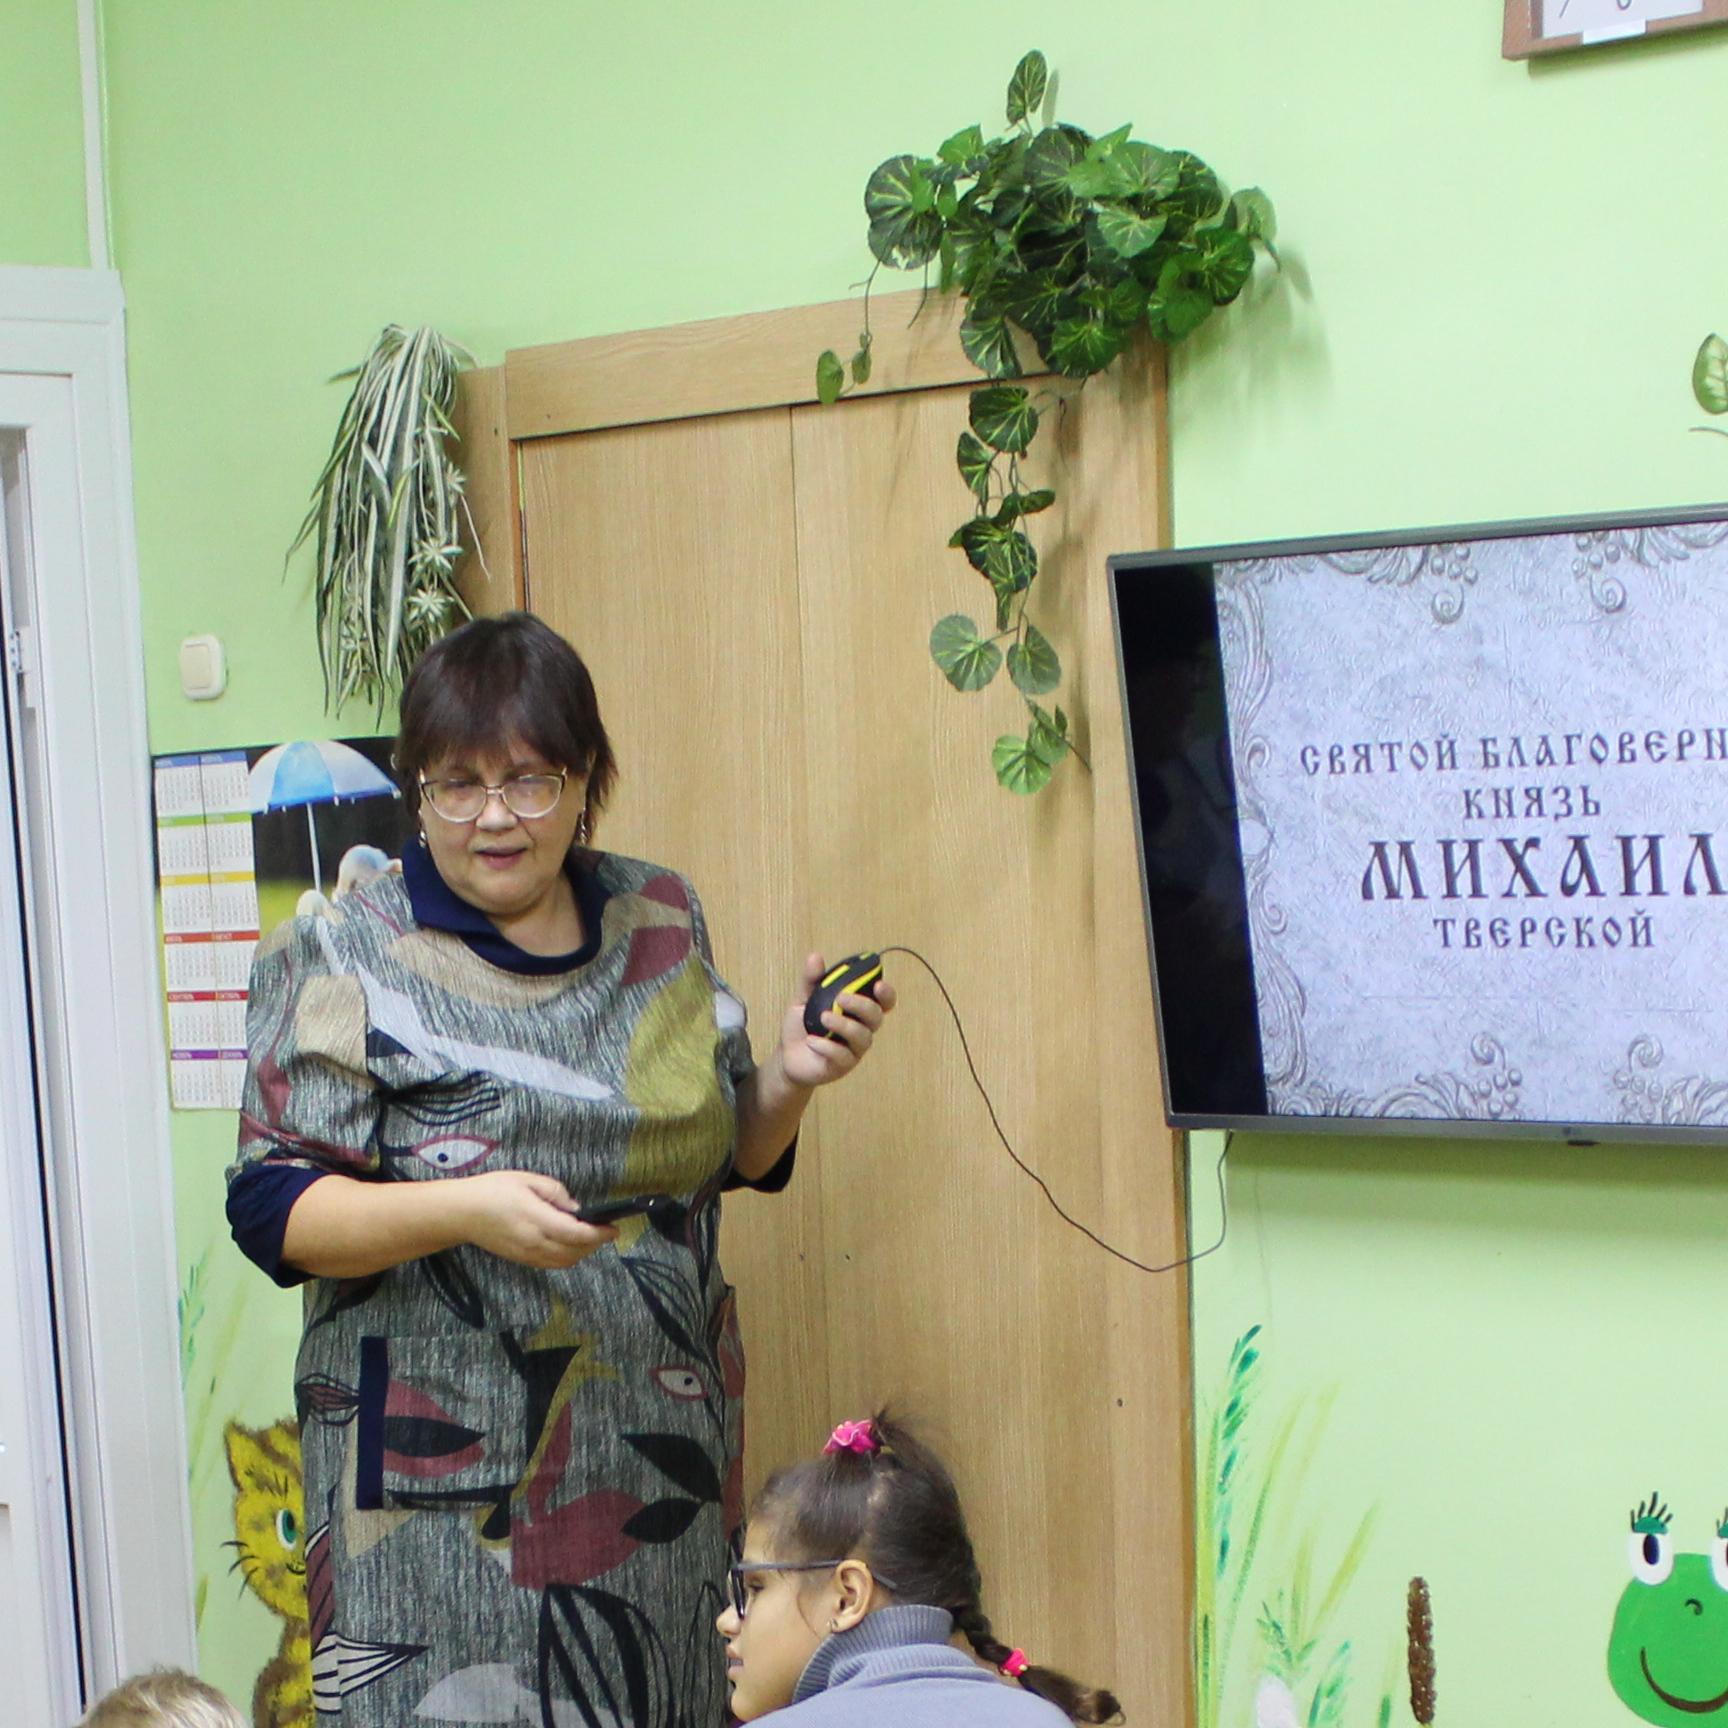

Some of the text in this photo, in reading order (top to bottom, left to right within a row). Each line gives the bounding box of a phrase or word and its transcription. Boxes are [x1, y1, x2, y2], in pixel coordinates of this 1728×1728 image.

[1299, 732, 1460, 776] СВЯТОЙ
[1462, 785, 1602, 821] КНЯЗЬ
[1433, 908, 1655, 949] ТВЕРСКОЙ
